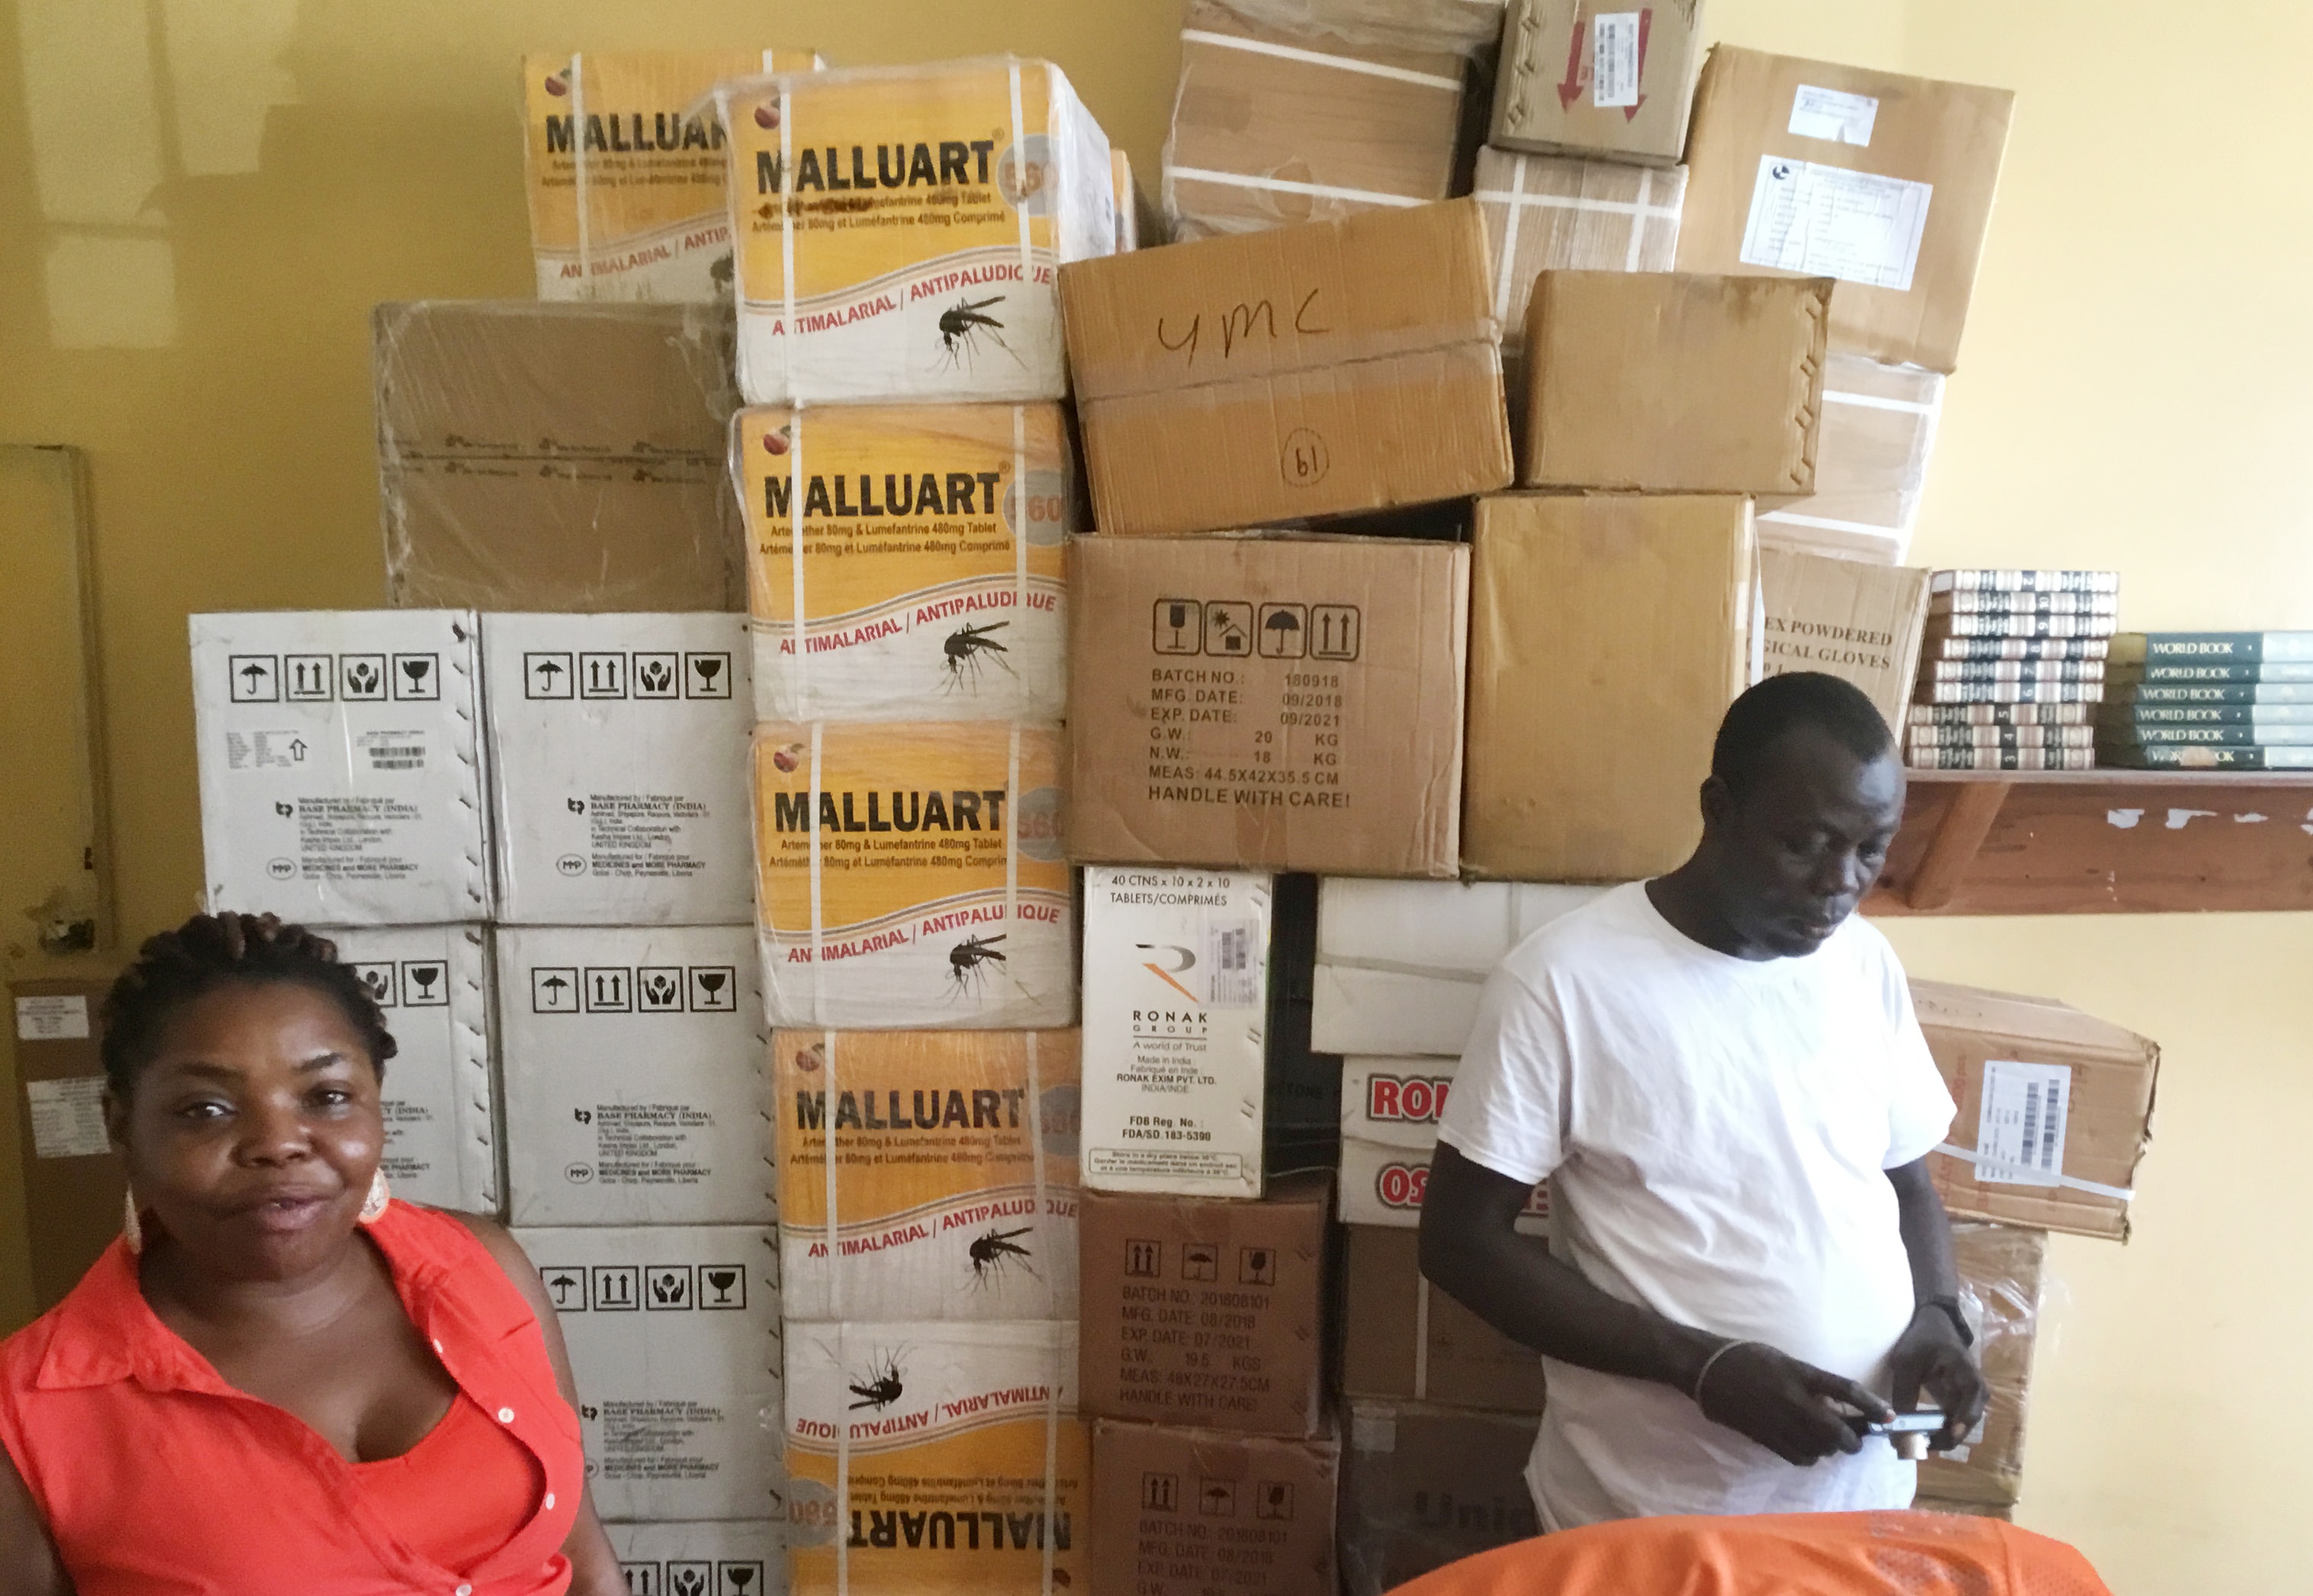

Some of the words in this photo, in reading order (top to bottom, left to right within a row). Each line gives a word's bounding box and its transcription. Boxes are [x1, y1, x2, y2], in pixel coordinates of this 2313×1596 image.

[757, 140, 994, 194] MALLUART
[560, 245, 671, 278] ANIMALARIAL
[772, 295, 897, 335] ATIMALARIAL
[764, 472, 1000, 519] MALLUART
[827, 523, 853, 538] 80mg
[857, 523, 863, 535] &
[866, 523, 929, 535] Lumefantrine
[932, 523, 964, 537] 480mg
[967, 522, 996, 533] Tablet
[816, 542, 842, 557] 80mg
[844, 542, 854, 554] et
[857, 541, 921, 554] Luméfantrine
[924, 541, 956, 555] 480mg
[960, 539, 1010, 554] Comprimé
[916, 591, 1057, 626] ANTIPALUDIUE
[780, 618, 902, 655] ATIMALARIAL
[1791, 621, 1893, 647] POWDERED
[2153, 642, 2197, 654] WORLD
[2200, 642, 2234, 654] BOOK
[1819, 648, 1890, 669] GLOVES
[1152, 668, 1206, 684] BATCH
[1285, 673, 1339, 687] 180918
[2151, 668, 2194, 678] WORLD
[2196, 668, 2230, 678] BOOK
[1195, 690, 1243, 704] DATE:
[1282, 693, 1342, 707] 09/2018
[2144, 689, 2188, 700] WORLD
[2191, 689, 2225, 700] BOOK
[1190, 709, 1237, 722] DATE:
[1280, 712, 1340, 726] 09/2021
[2140, 710, 2184, 721] WORLD
[2187, 710, 2221, 720] BOOK
[1255, 730, 1272, 744] 20
[1315, 732, 1338, 746] KG
[2141, 730, 2186, 741] WORLD
[2189, 729, 2224, 740] BOOK
[1253, 751, 1271, 764] 18
[1314, 752, 1337, 765] KG
[1315, 771, 1339, 785] CM
[1149, 786, 1228, 803] HANDLE
[1234, 789, 1283, 806] WITH
[1289, 791, 1350, 809] CARE!
[775, 790, 1005, 832] MALLUART
[835, 839, 861, 852] 80mg
[864, 839, 870, 850] &
[873, 839, 935, 850] Lumefantrine
[939, 838, 970, 852] 480mg
[973, 838, 1002, 849] Tablet
[824, 856, 850, 870] 80mg
[853, 857, 861, 867] et
[864, 856, 928, 867] Luméfantrine
[931, 856, 963, 869] 480mg
[1111, 875, 1125, 886] 40
[1129, 876, 1157, 886] CTNS
[1172, 877, 1184, 886] 10
[1197, 877, 1203, 887] 2
[1218, 877, 1230, 888] 10
[1110, 892, 1227, 906] TABLETS/COMPRIMÉS
[922, 904, 1060, 936] ANTIPALUIQUE
[788, 925, 909, 963] ANIMALARIAL
[1133, 1010, 1207, 1023] RONAK
[1133, 1025, 1207, 1034] GROUP
[1143, 1042, 1170, 1051] world
[1185, 1043, 1207, 1051] Trust
[1137, 1055, 1160, 1064] Made
[1172, 1057, 1192, 1065] India
[1117, 1073, 1149, 1082] RONAK
[1152, 1074, 1173, 1083] EXIM
[1141, 1084, 1189, 1093] INDIA/INDE
[796, 1086, 1025, 1131] MALLUART
[809, 1222, 929, 1257] ANIMALARIAL
[1123, 1285, 1166, 1302] BATCH
[1120, 1388, 1172, 1405] HANDLE
[1178, 1393, 1214, 1408] WITH
[796, 1411, 928, 1439] ANTIPALUIQUE
[846, 1511, 1071, 1550] MALLUART
